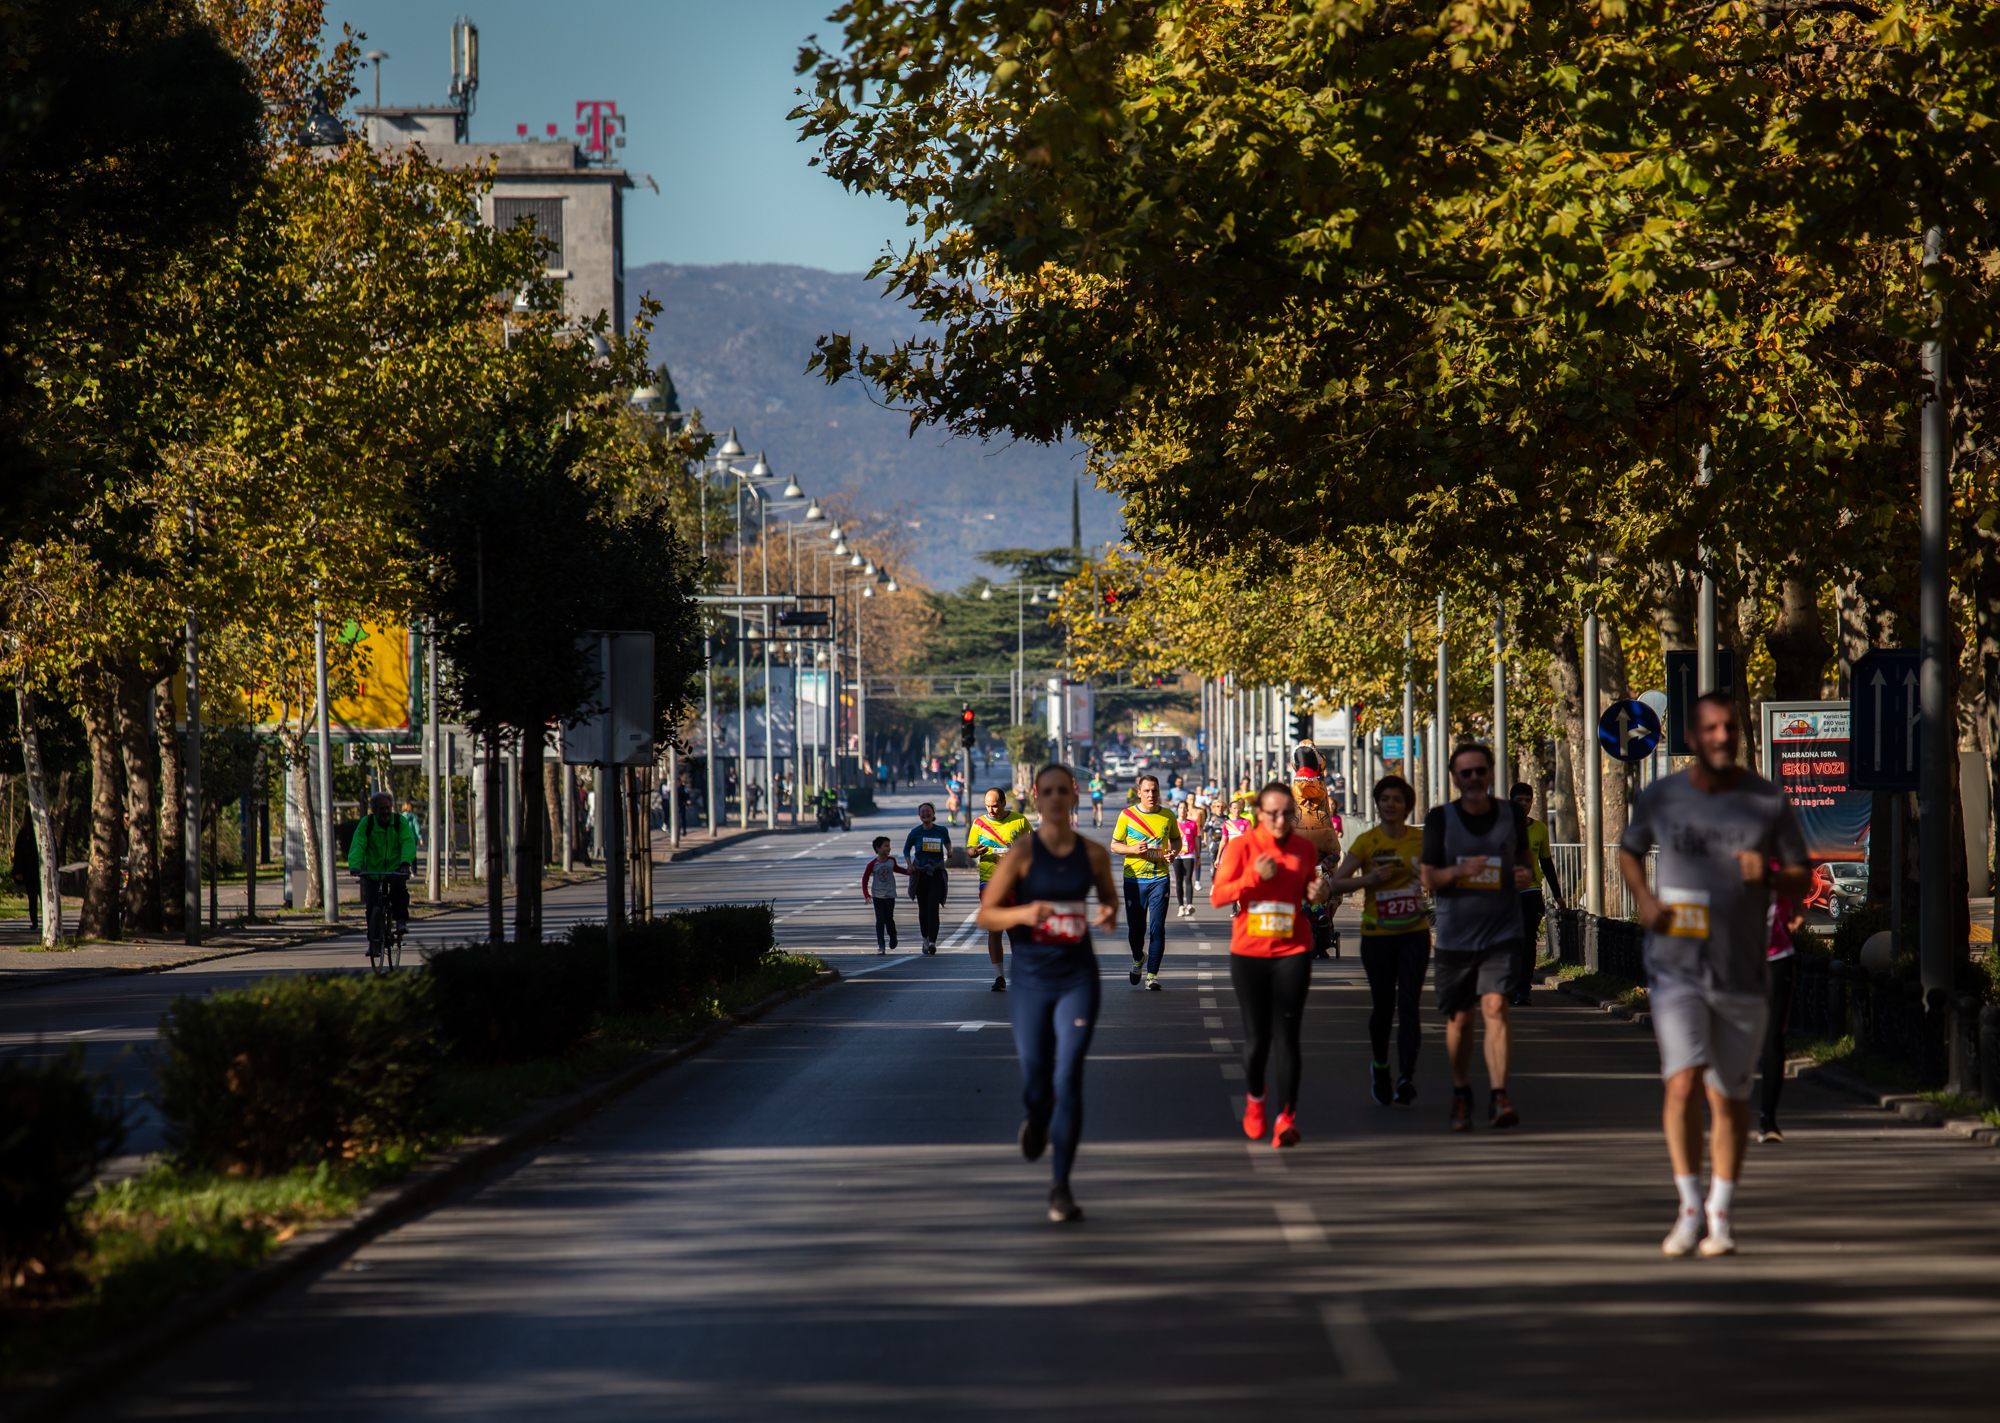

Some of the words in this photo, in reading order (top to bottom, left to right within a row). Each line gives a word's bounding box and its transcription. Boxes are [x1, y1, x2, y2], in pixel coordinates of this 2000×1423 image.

[1782, 763, 1810, 775] EKO
[1813, 762, 1844, 774] VOZI
[1783, 785, 1793, 793] 2x
[1795, 785, 1816, 793] Nova
[1818, 784, 1846, 794] Toyota
[1801, 797, 1835, 807] nagrada
[926, 842, 940, 850] 1235
[1146, 850, 1163, 859] IVAN
